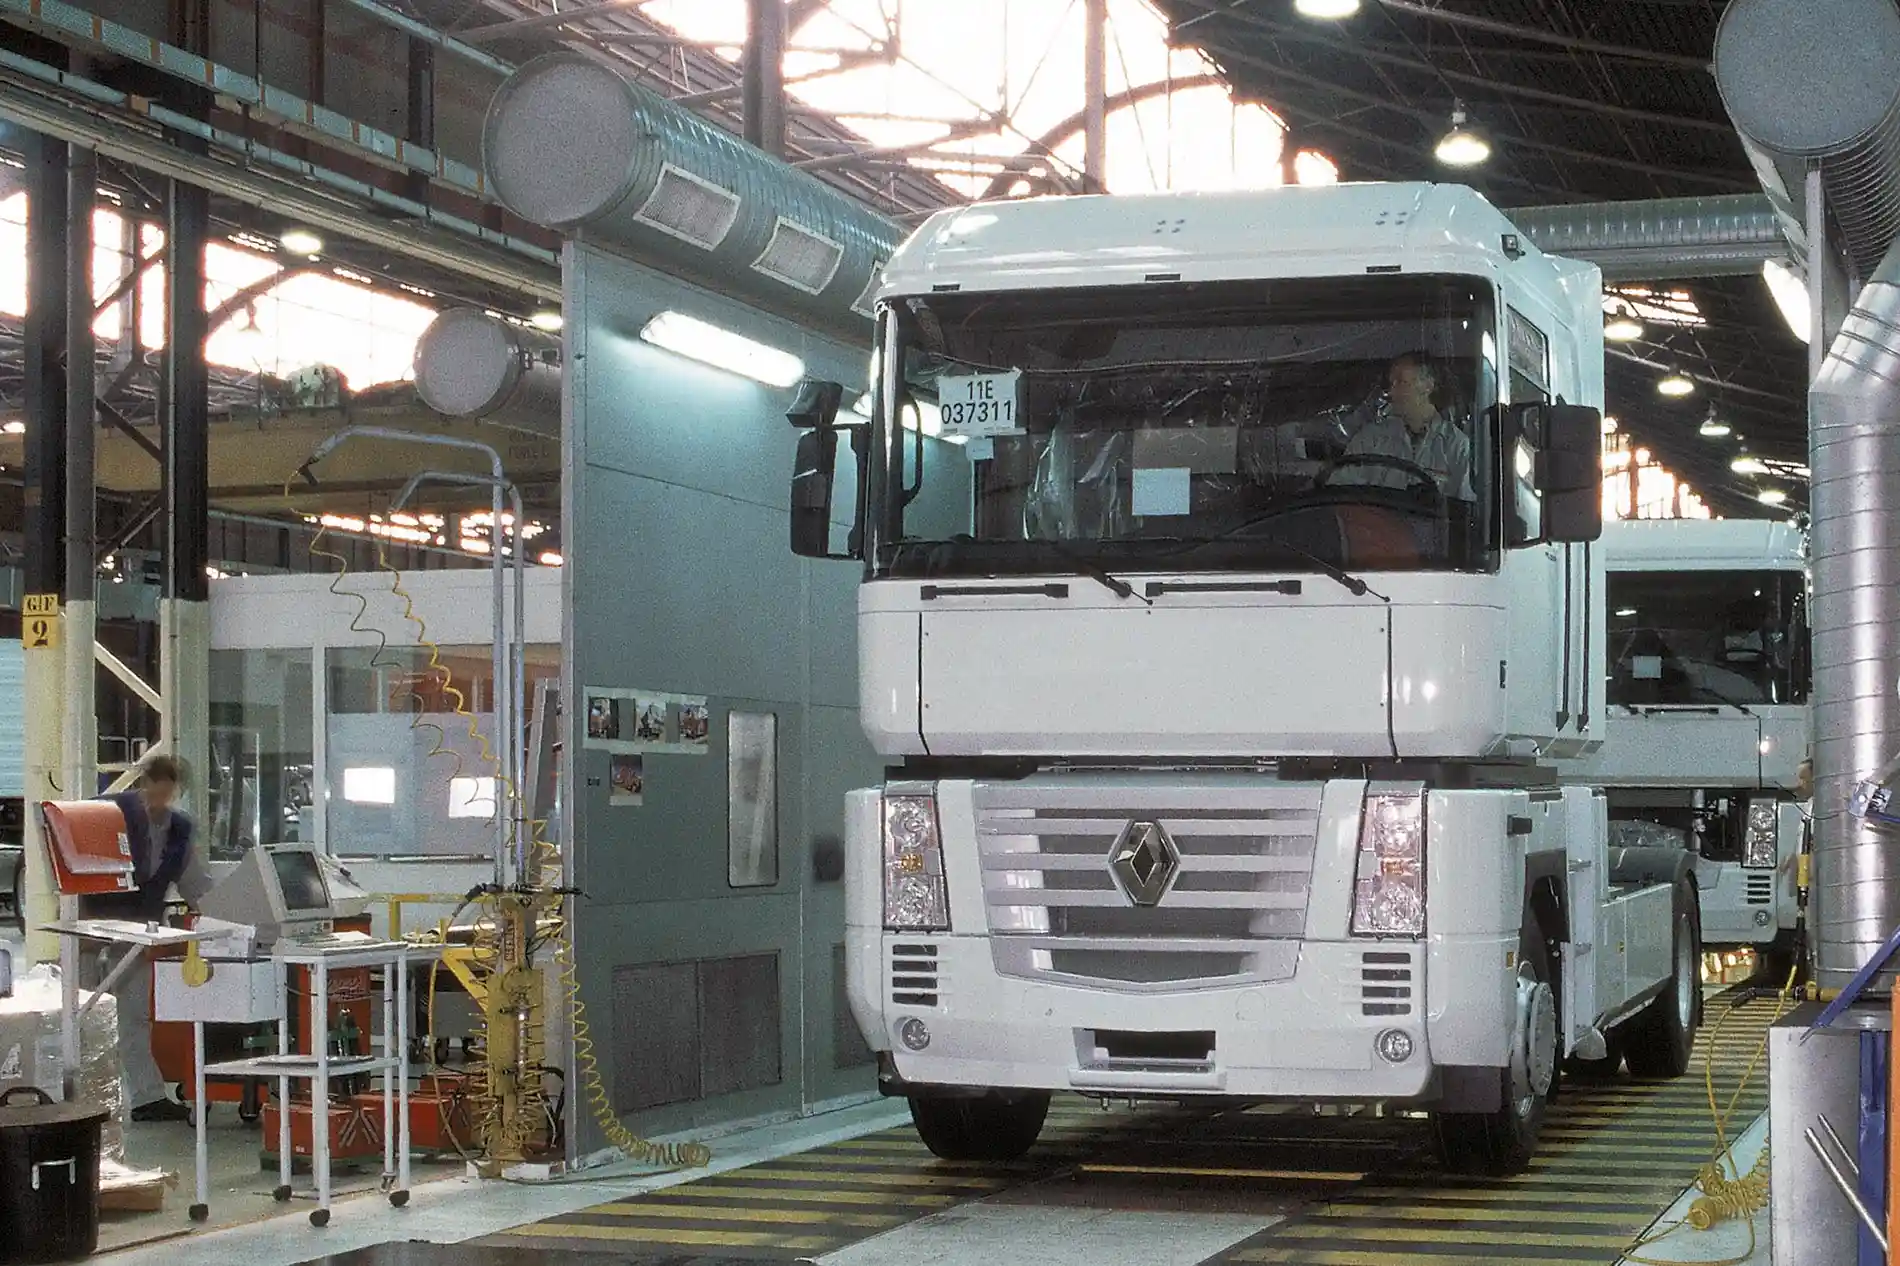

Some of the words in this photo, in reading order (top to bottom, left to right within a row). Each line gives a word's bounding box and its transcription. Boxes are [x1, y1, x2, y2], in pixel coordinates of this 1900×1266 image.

[967, 380, 993, 400] 11E
[941, 400, 1011, 424] 037311
[32, 620, 48, 646] 2
